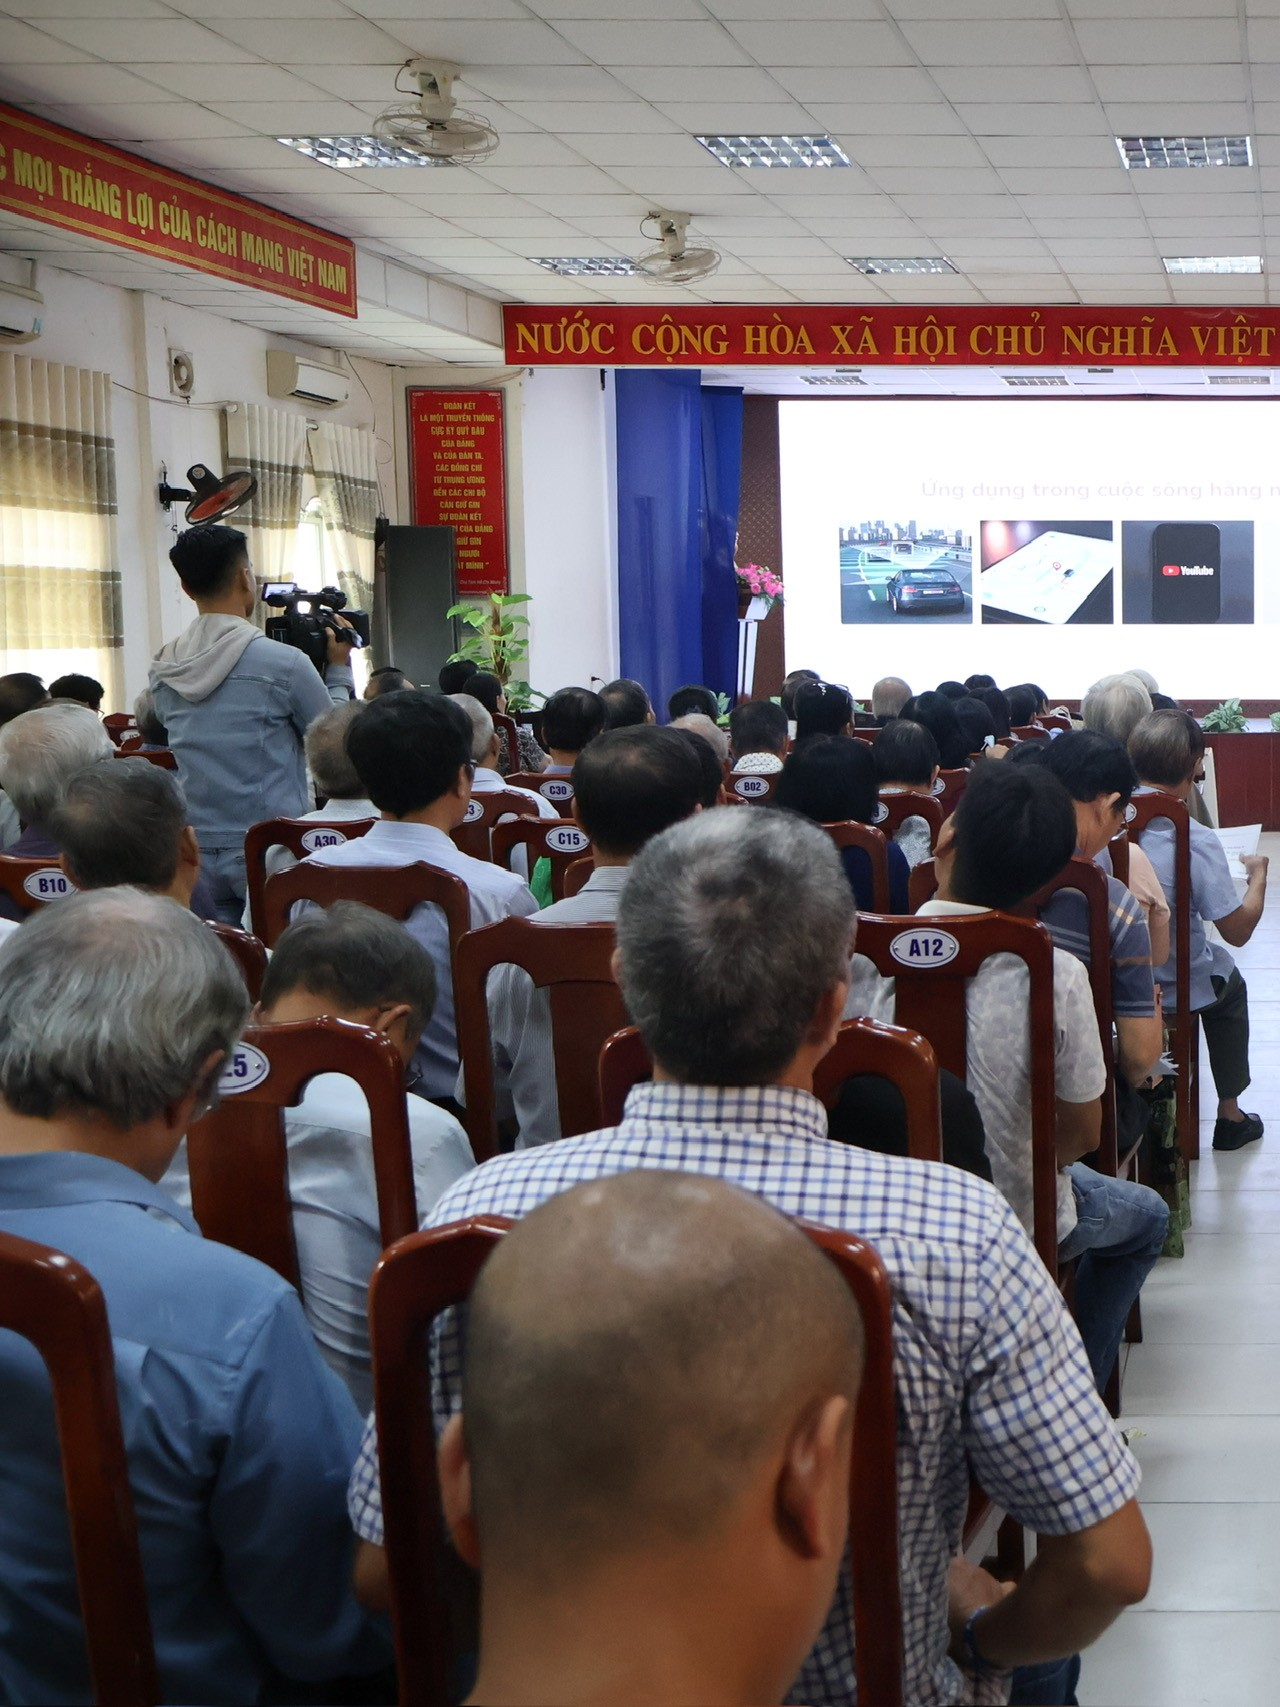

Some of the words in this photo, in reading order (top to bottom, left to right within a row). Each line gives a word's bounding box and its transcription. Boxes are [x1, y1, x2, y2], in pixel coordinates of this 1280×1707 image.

[13, 148, 54, 201] MỌI
[58, 162, 122, 220] THẮNG
[127, 189, 154, 235] LỢI
[158, 195, 193, 243] CỦA
[196, 212, 238, 258] CÁCH
[241, 231, 284, 273] MẠNG
[287, 246, 314, 287] VIỆT
[317, 258, 347, 295] NAM
[516, 310, 615, 355] NƯỚC
[631, 315, 729, 362] CỘNG
[743, 313, 816, 355] HÒA
[830, 316, 880, 355] XÃ
[893, 316, 957, 362] HỘI
[968, 310, 1046, 355] CHỦ
[1061, 316, 1179, 356] NGHĨA
[1190, 315, 1276, 362] VIỆT
[921, 475, 964, 500] Ứng
[972, 482, 1025, 500] dụng
[1033, 483, 1090, 500] trong
[1098, 481, 1145, 500] cuộc
[1180, 565, 1215, 576] YouTube
[550, 786, 567, 795] C30
[744, 781, 762, 791] B02
[314, 835, 337, 848] A30
[558, 832, 580, 845] C15
[39, 878, 67, 893] B10
[909, 938, 943, 957] A12
